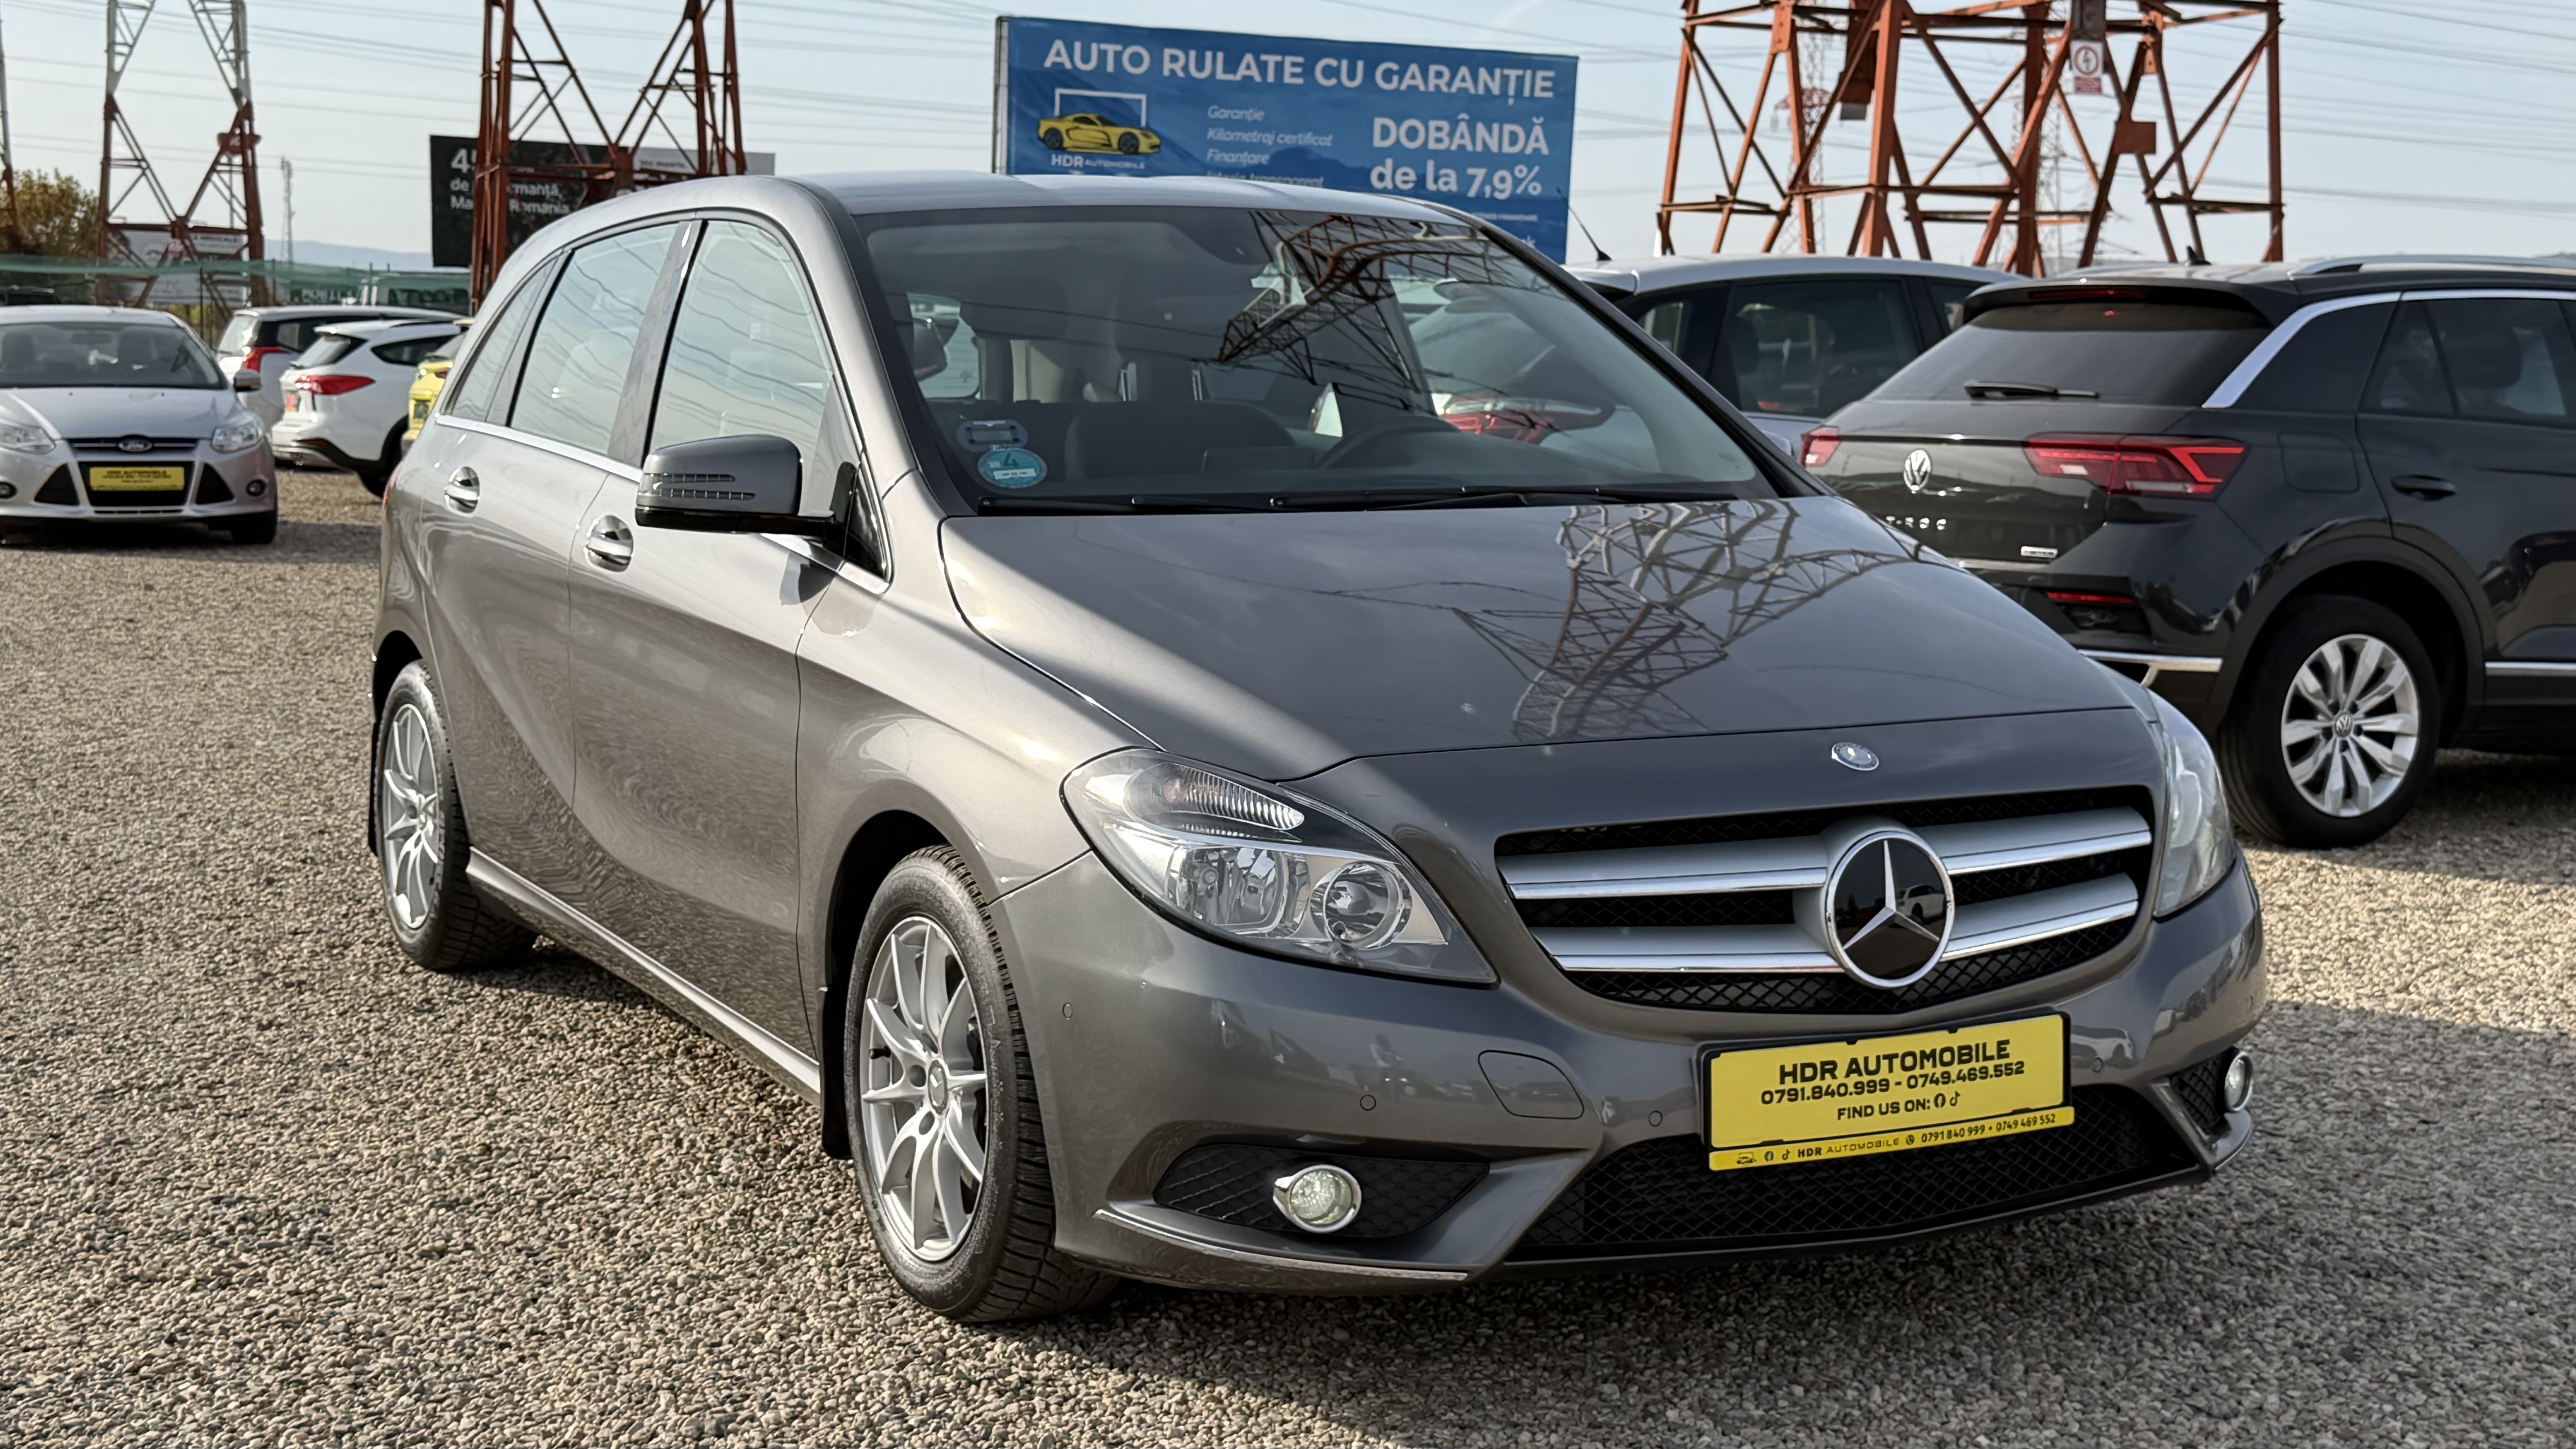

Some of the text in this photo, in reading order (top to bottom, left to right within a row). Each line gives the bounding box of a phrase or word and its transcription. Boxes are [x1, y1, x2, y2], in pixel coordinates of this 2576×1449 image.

[1044, 39, 1555, 106] AUTO RULATE CU GARANȚIE
[1372, 113, 1550, 156] DOBÂNDĂ
[1051, 154, 1084, 168] HDR
[1370, 158, 1542, 200] de la 7,9%
[1761, 1078, 1890, 1105] 0791.840.999
[1907, 1061, 2025, 1089] 0749.469.552
[1779, 1039, 2010, 1085] HDR AUTOMOBILE
[1837, 1098, 1931, 1120] FIND US ON:
[1798, 1147, 1822, 1158] HDR
[1826, 1138, 1899, 1154] AUTOMOBILE
[1921, 1130, 1944, 1143] 0791
[1967, 1125, 1985, 1136] 999
[1996, 1119, 2019, 1132] 0749
